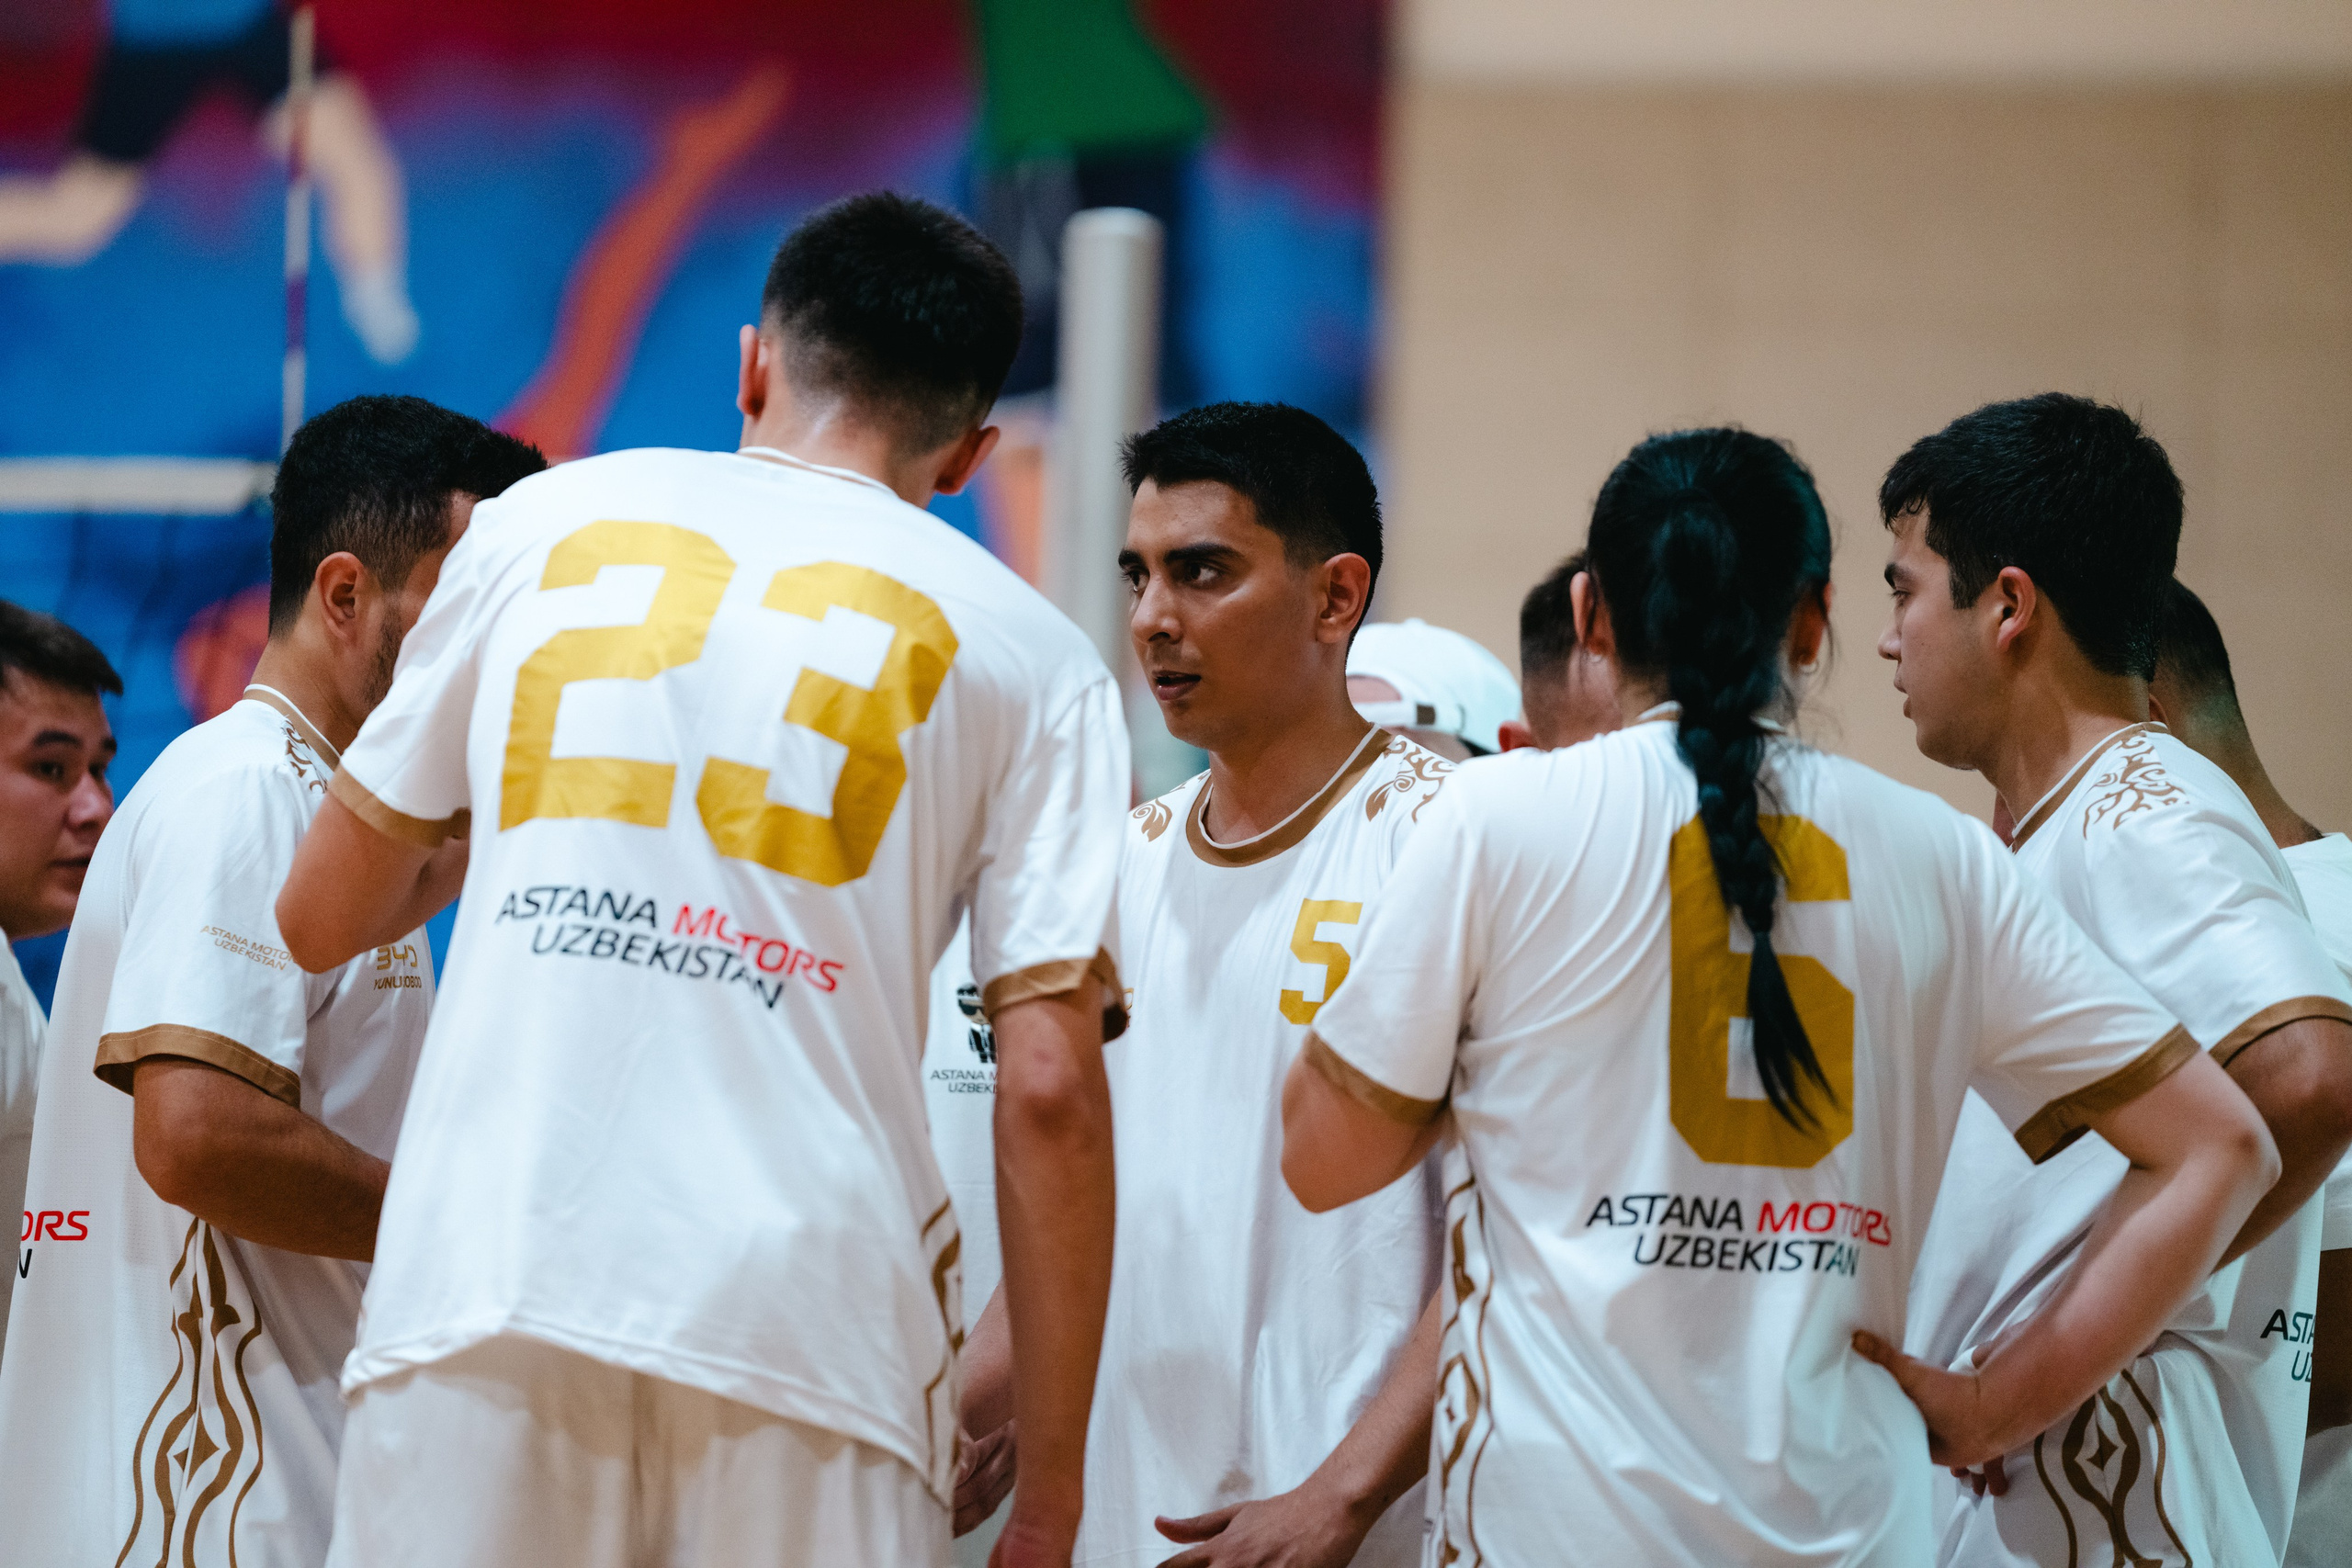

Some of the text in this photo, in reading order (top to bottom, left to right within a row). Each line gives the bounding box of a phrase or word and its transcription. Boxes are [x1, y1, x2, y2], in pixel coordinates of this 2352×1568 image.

[498, 519, 959, 887] 23
[495, 886, 657, 929] ASTANA
[199, 925, 294, 962] ASTANA MOTO
[214, 938, 287, 971] UZBEKISTAN
[1279, 897, 1363, 1025] 5
[373, 975, 423, 990] YUNUOBOD
[531, 924, 784, 1010] UZBEKISTAN
[1670, 813, 1854, 1168] 6
[930, 1069, 985, 1081] ASTANA
[947, 1082, 996, 1094] UZBEKI
[1585, 1194, 1893, 1247] ASTANA MOTORS
[1634, 1234, 1861, 1277] UZBEKISTAN
